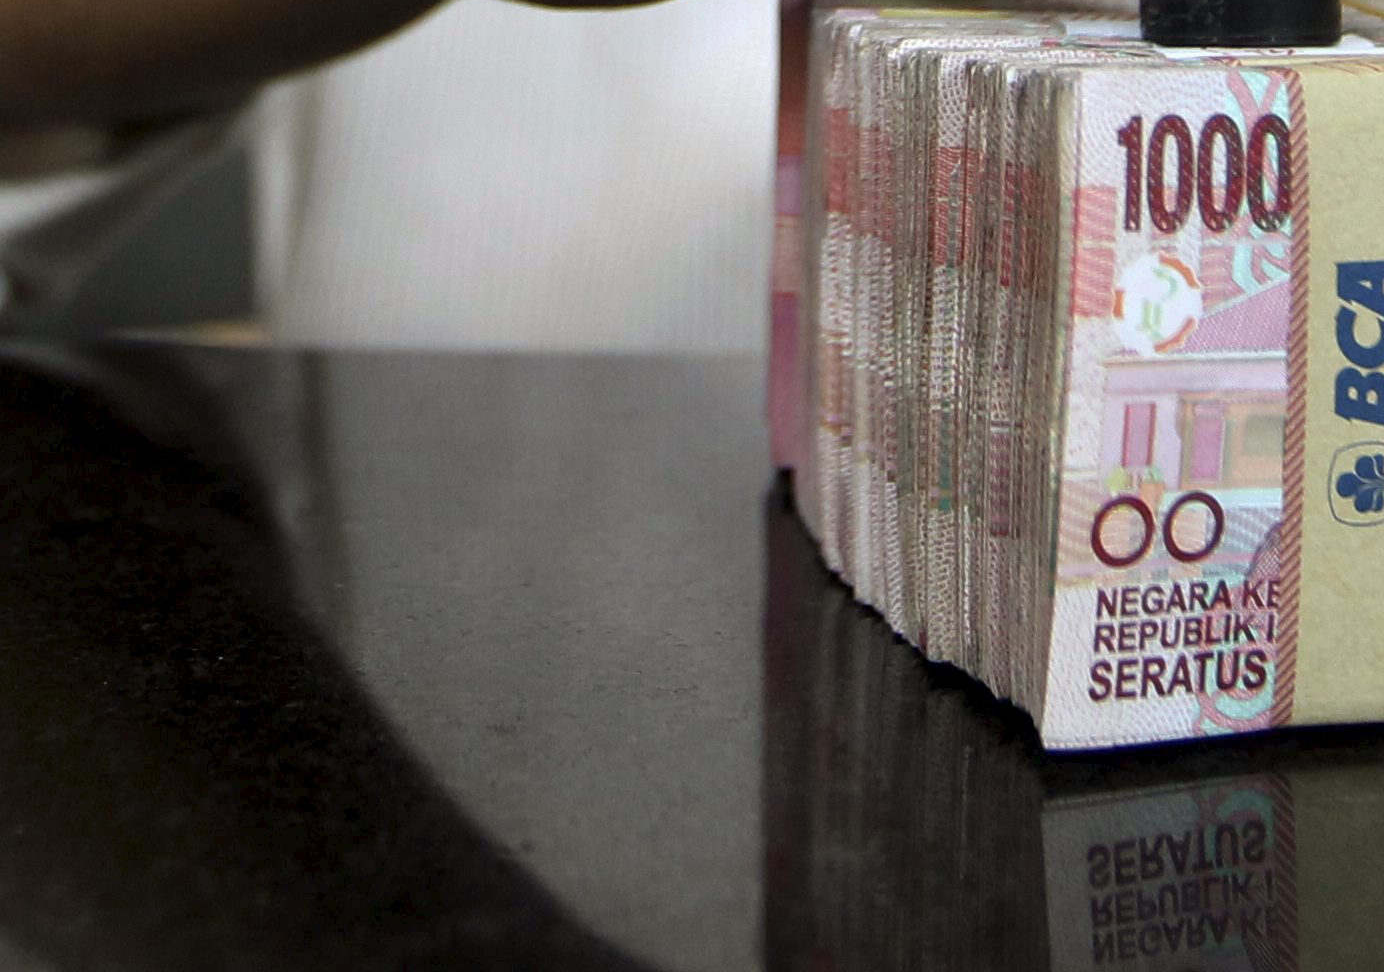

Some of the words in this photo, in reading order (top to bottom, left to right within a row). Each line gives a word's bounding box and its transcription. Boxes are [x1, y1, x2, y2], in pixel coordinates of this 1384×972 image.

[1096, 579, 1232, 620] NEGARA
[1093, 613, 1258, 653] REPUBLIK
[1088, 649, 1269, 703] SERATUS
